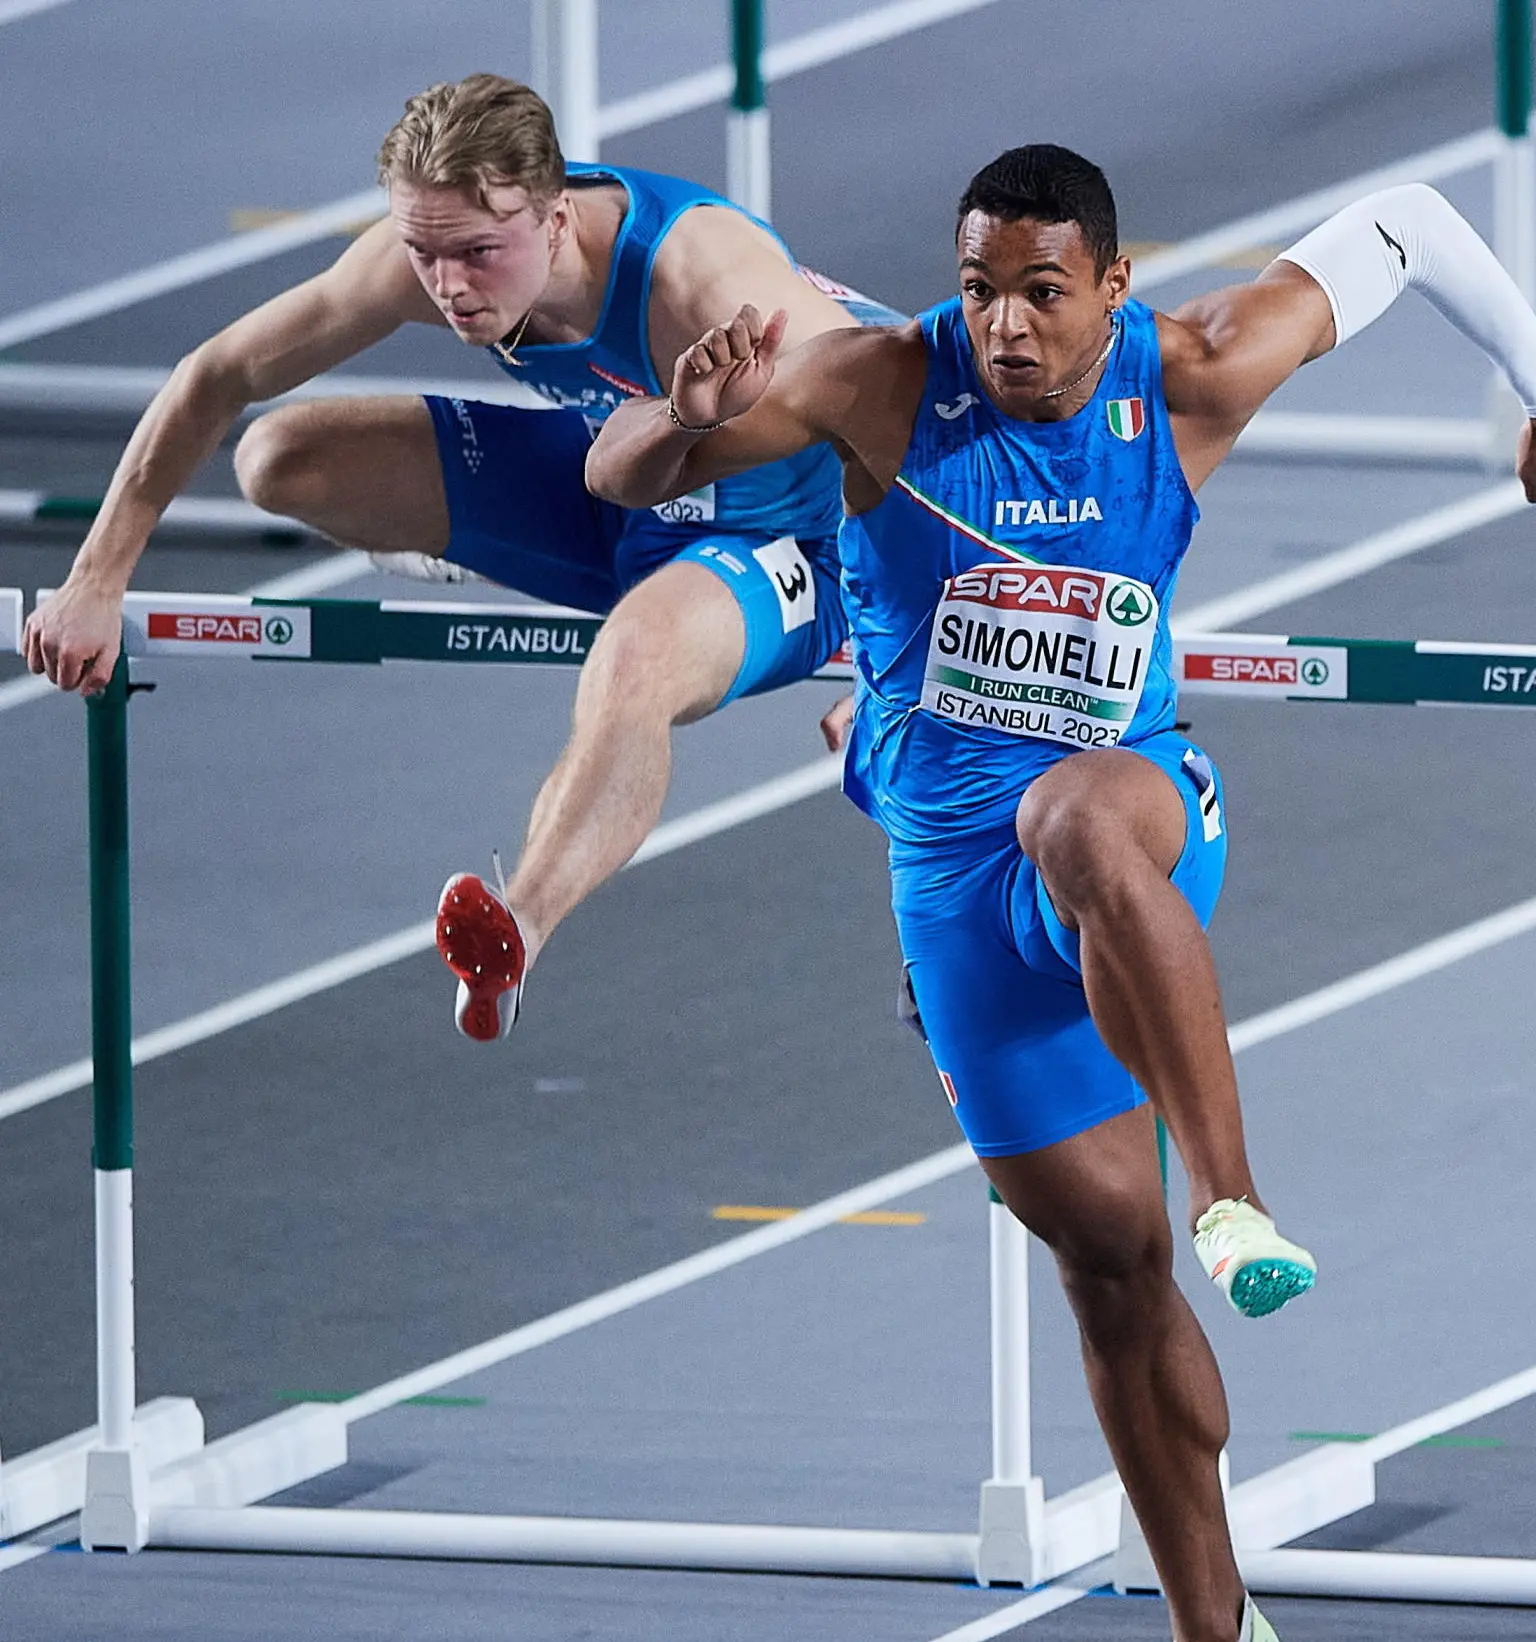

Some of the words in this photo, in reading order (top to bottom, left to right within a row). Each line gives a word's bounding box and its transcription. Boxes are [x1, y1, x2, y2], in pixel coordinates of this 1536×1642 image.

[995, 497, 1103, 526] ITALIA
[776, 562, 807, 603] 3
[951, 573, 1098, 614] SPAR
[176, 617, 259, 641] SPAR
[447, 626, 585, 654] ISTANBUL
[937, 614, 1142, 691] SIMONELLI
[1211, 659, 1297, 682] SPAR
[970, 679, 976, 690] I
[980, 680, 1022, 700] RUN
[936, 690, 1056, 735] ISTANBUL
[1061, 717, 1120, 748] 2023
